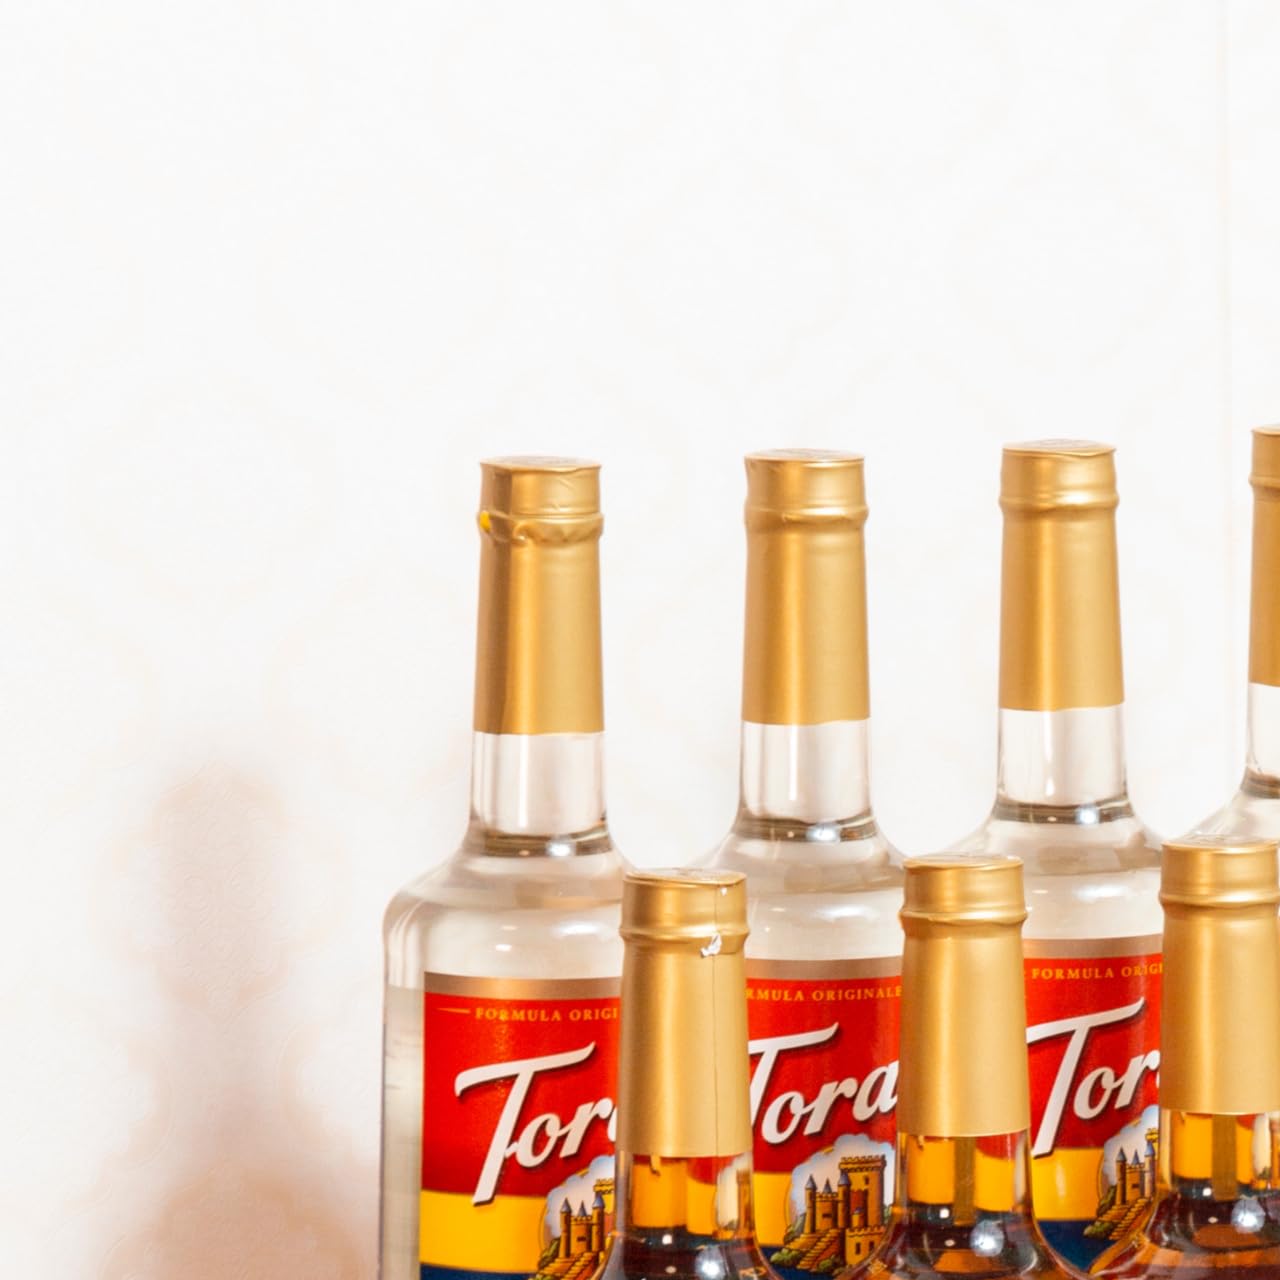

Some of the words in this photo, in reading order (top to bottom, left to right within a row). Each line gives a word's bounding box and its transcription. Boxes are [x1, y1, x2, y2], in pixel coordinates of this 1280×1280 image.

[811, 985, 902, 1001] ORIGINALE
[1031, 967, 1115, 980] FORMULA
[1120, 963, 1163, 978] ORIGI
[475, 1007, 562, 1022] FORMULA
[568, 1007, 617, 1021] ORIGI
[747, 1021, 900, 1145] Tora
[1025, 996, 1161, 1158] Tor
[454, 1041, 618, 1206] Tor
